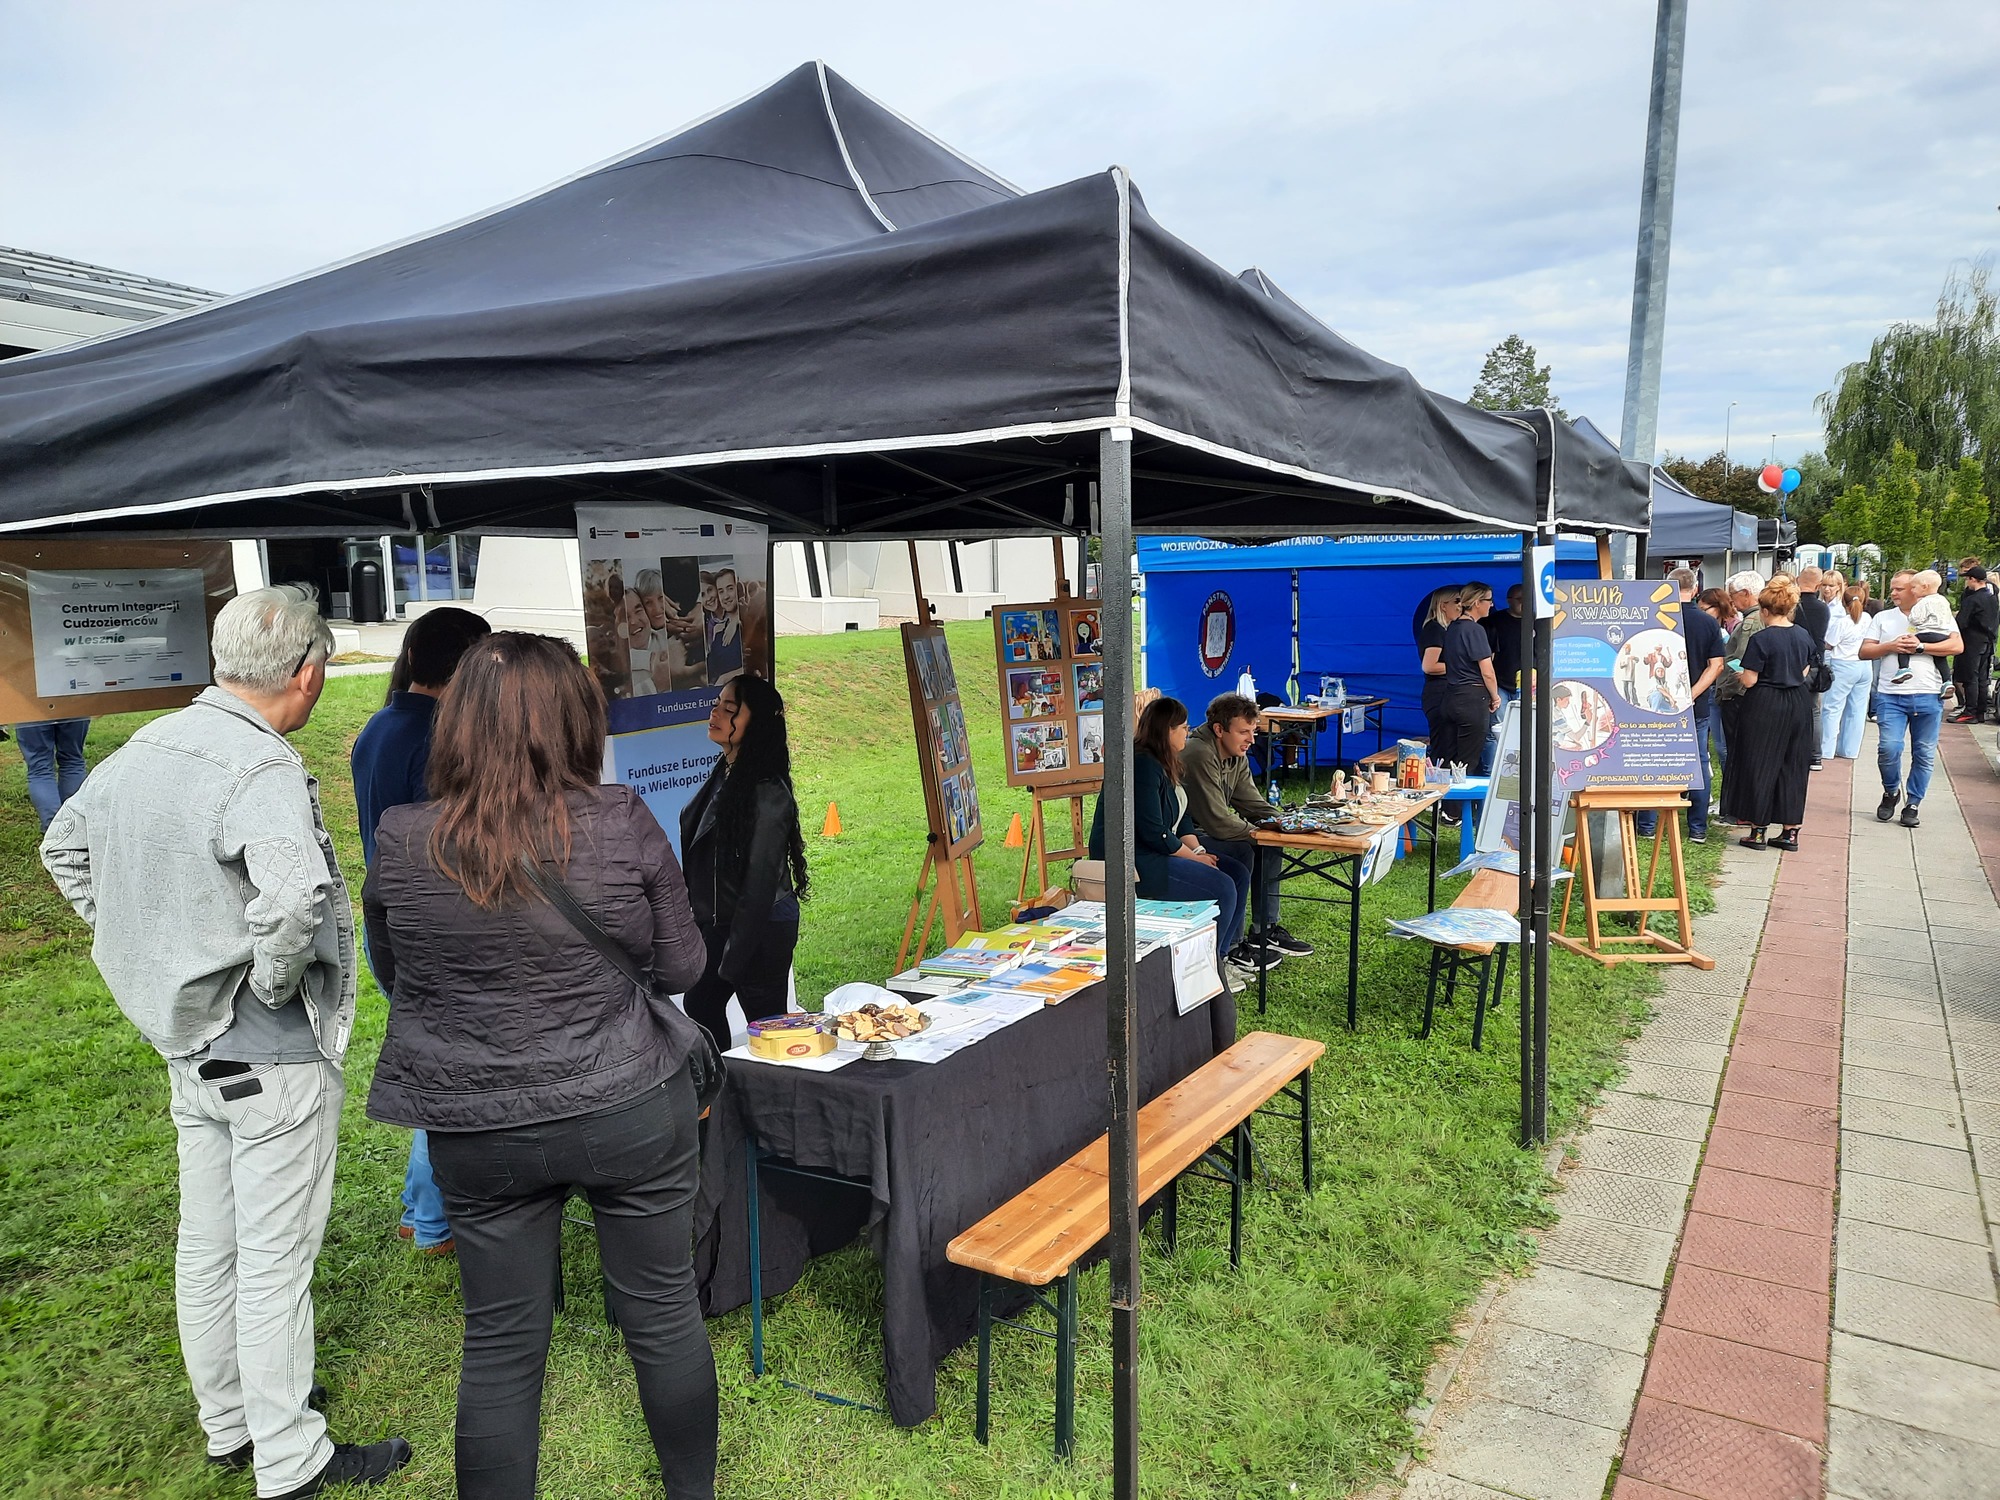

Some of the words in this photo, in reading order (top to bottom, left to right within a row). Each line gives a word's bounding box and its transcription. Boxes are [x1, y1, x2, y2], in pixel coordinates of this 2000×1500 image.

[1160, 539, 1229, 552] WOJEWÓDZKA
[1266, 535, 1324, 548] SANITARNO
[1334, 533, 1441, 545] PIDEMIOLOGICZNA
[1570, 584, 1623, 606] KLUB
[61, 602, 120, 614] Centrum
[122, 600, 180, 614] Integracji
[1571, 606, 1650, 620] KWADRAT
[62, 615, 159, 629] Cudzoziemców
[63, 636, 77, 646] w
[78, 632, 126, 645] Lesznie
[657, 700, 697, 714] Fundusze
[628, 761, 680, 780] Fundusze
[1587, 773, 1640, 784] Zapraszamy
[1642, 773, 1654, 782] do
